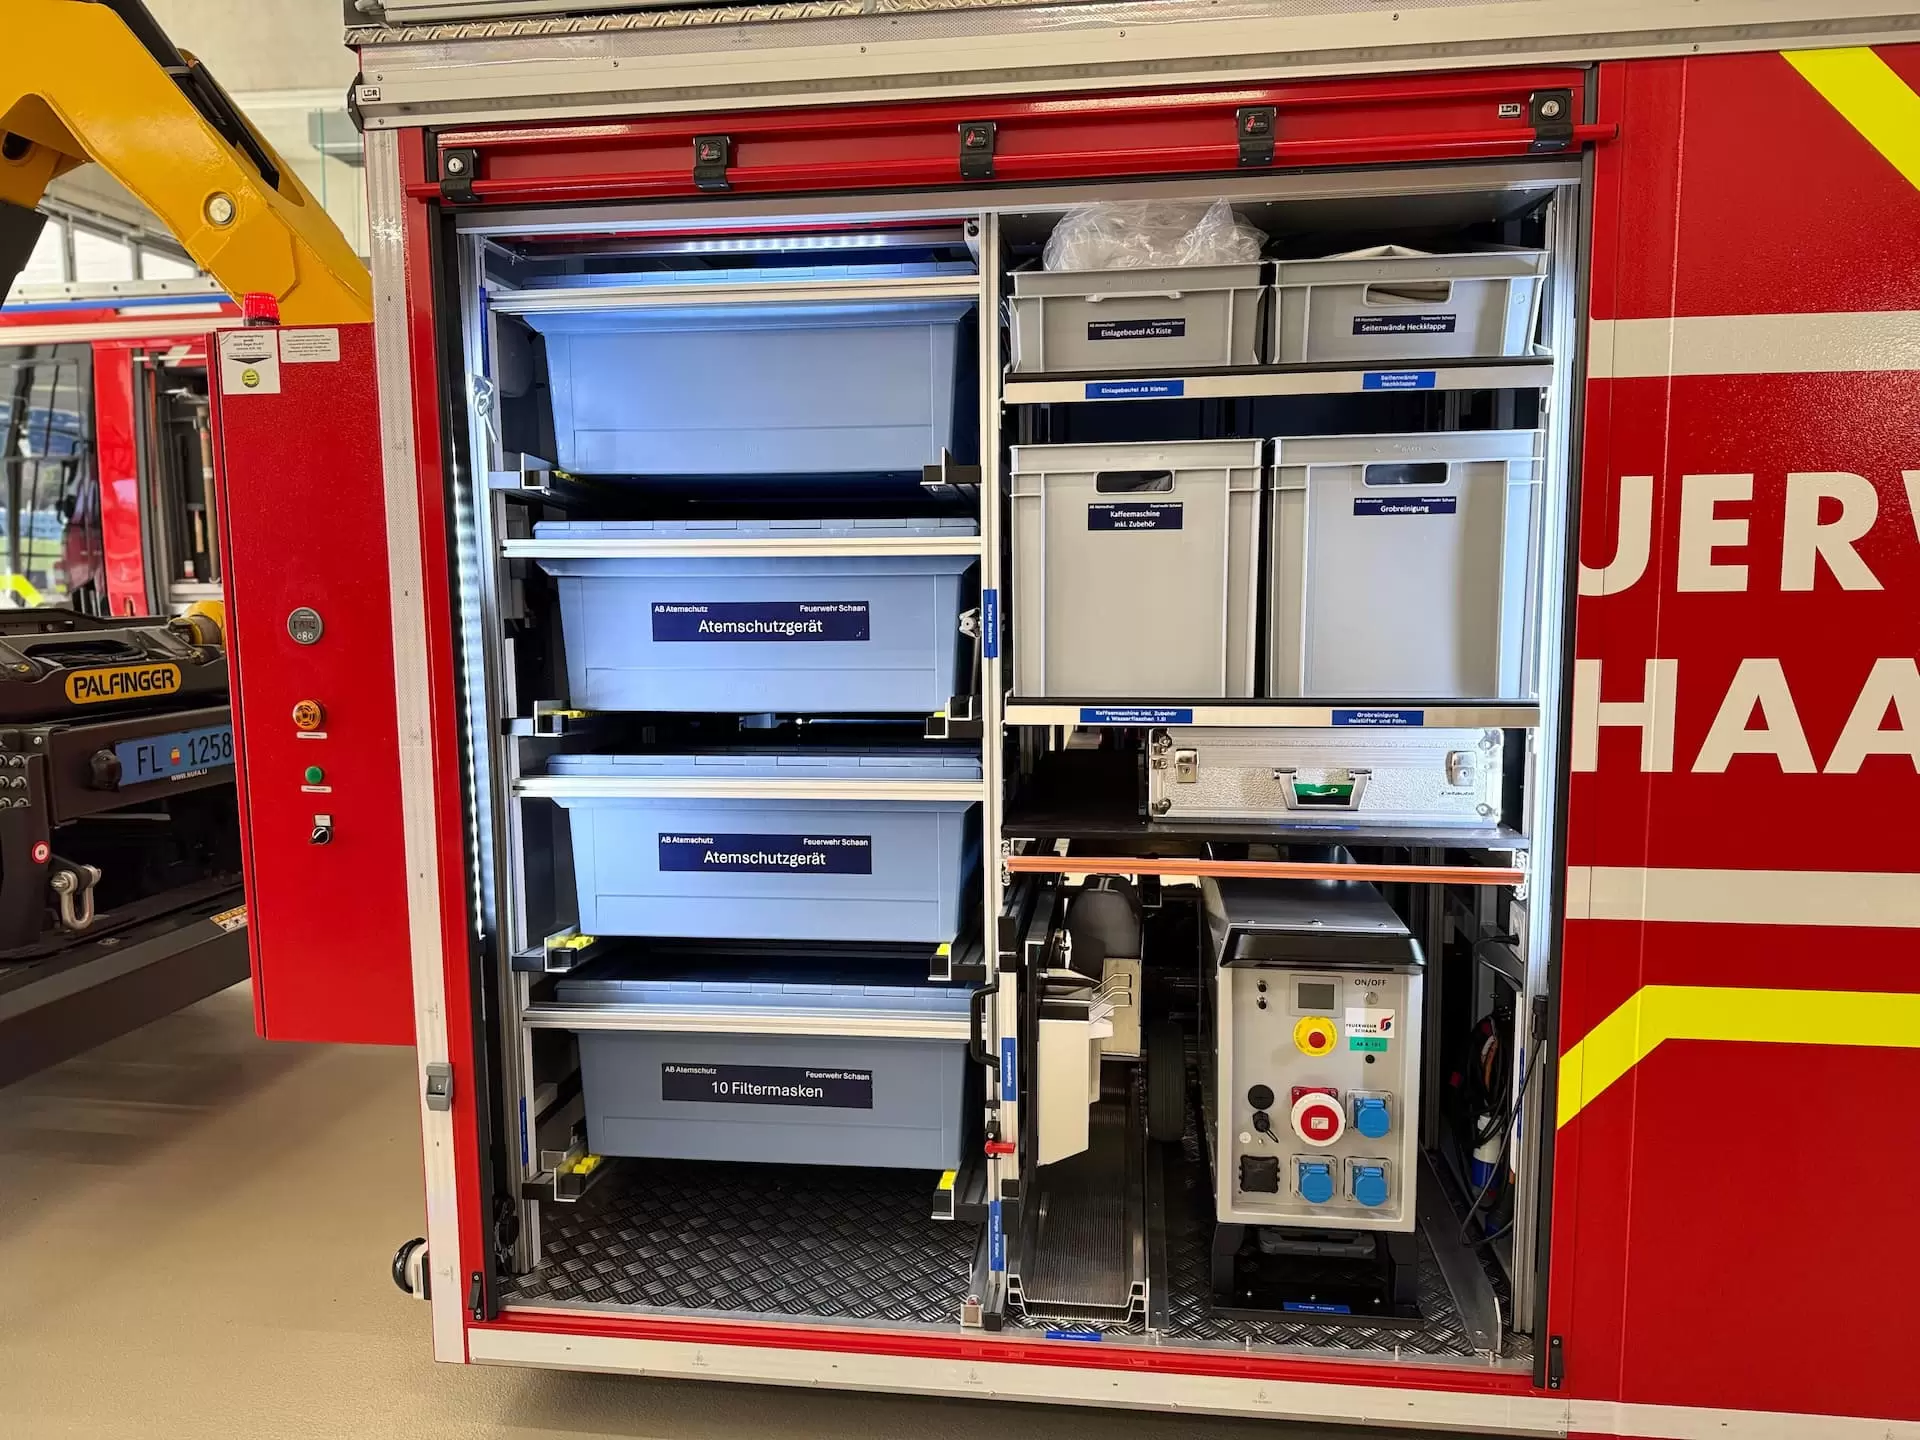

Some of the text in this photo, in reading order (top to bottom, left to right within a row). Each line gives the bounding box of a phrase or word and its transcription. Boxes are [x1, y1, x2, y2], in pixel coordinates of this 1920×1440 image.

[1101, 328, 1144, 338] Einlagebeutel
[1407, 323, 1446, 331] Heckklappe
[1380, 505, 1429, 513] Grobreinigung
[698, 619, 823, 636] Atemschutzgerät
[73, 668, 175, 698] PALFINGER
[1571, 658, 1920, 774] HAA
[137, 732, 232, 776] FL 1258
[704, 850, 826, 867] Atemschutzgerät
[806, 1071, 842, 1079] Feuerwehr
[712, 1081, 823, 1098] 10 Filtermasken
